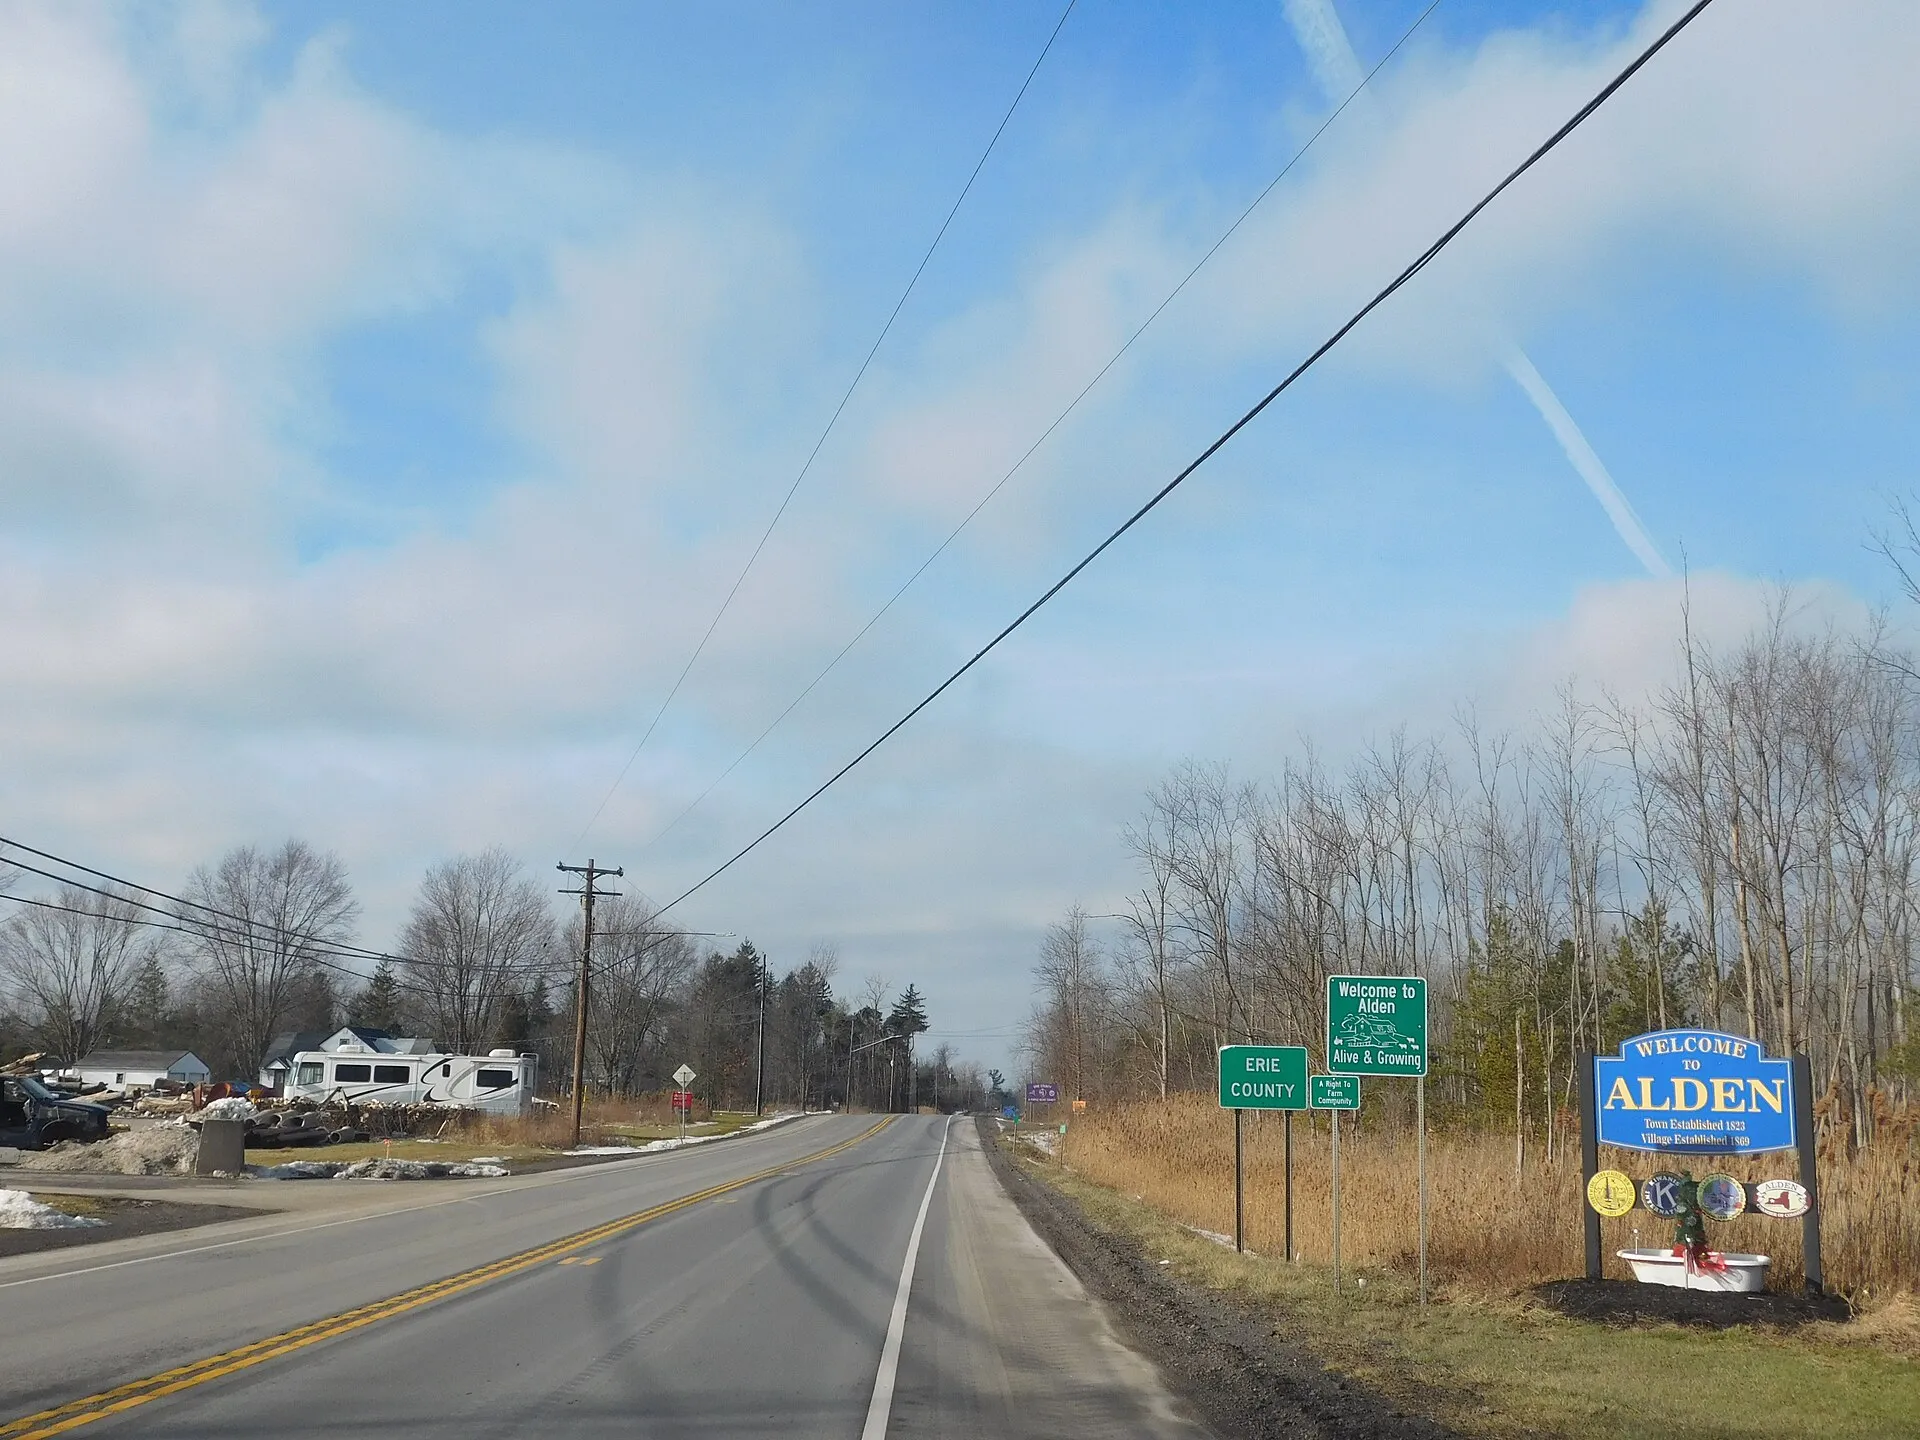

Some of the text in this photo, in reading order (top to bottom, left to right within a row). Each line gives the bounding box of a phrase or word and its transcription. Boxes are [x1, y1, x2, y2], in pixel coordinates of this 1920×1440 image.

[1338, 982, 1416, 998] Welcome to
[1358, 998, 1395, 1014] Alden
[1636, 1036, 1747, 1059] WELCOME
[1246, 1057, 1280, 1072] ERIE
[1333, 1049, 1421, 1070] Alive & Growing
[1682, 1060, 1700, 1070] TO
[1231, 1082, 1295, 1098] COUNTY
[1325, 1081, 1342, 1089] Right
[1318, 1097, 1352, 1106] Community
[1604, 1077, 1785, 1114] ALDEN
[1644, 1118, 1746, 1131] Town Established 1823
[1641, 1133, 1750, 1146] Village Established 1869
[1648, 1175, 1680, 1187] KIWANIS
[1765, 1181, 1797, 1191] ALDEN
[1644, 1190, 1680, 1215] INTERNATI
[1655, 1182, 1677, 1209] K
